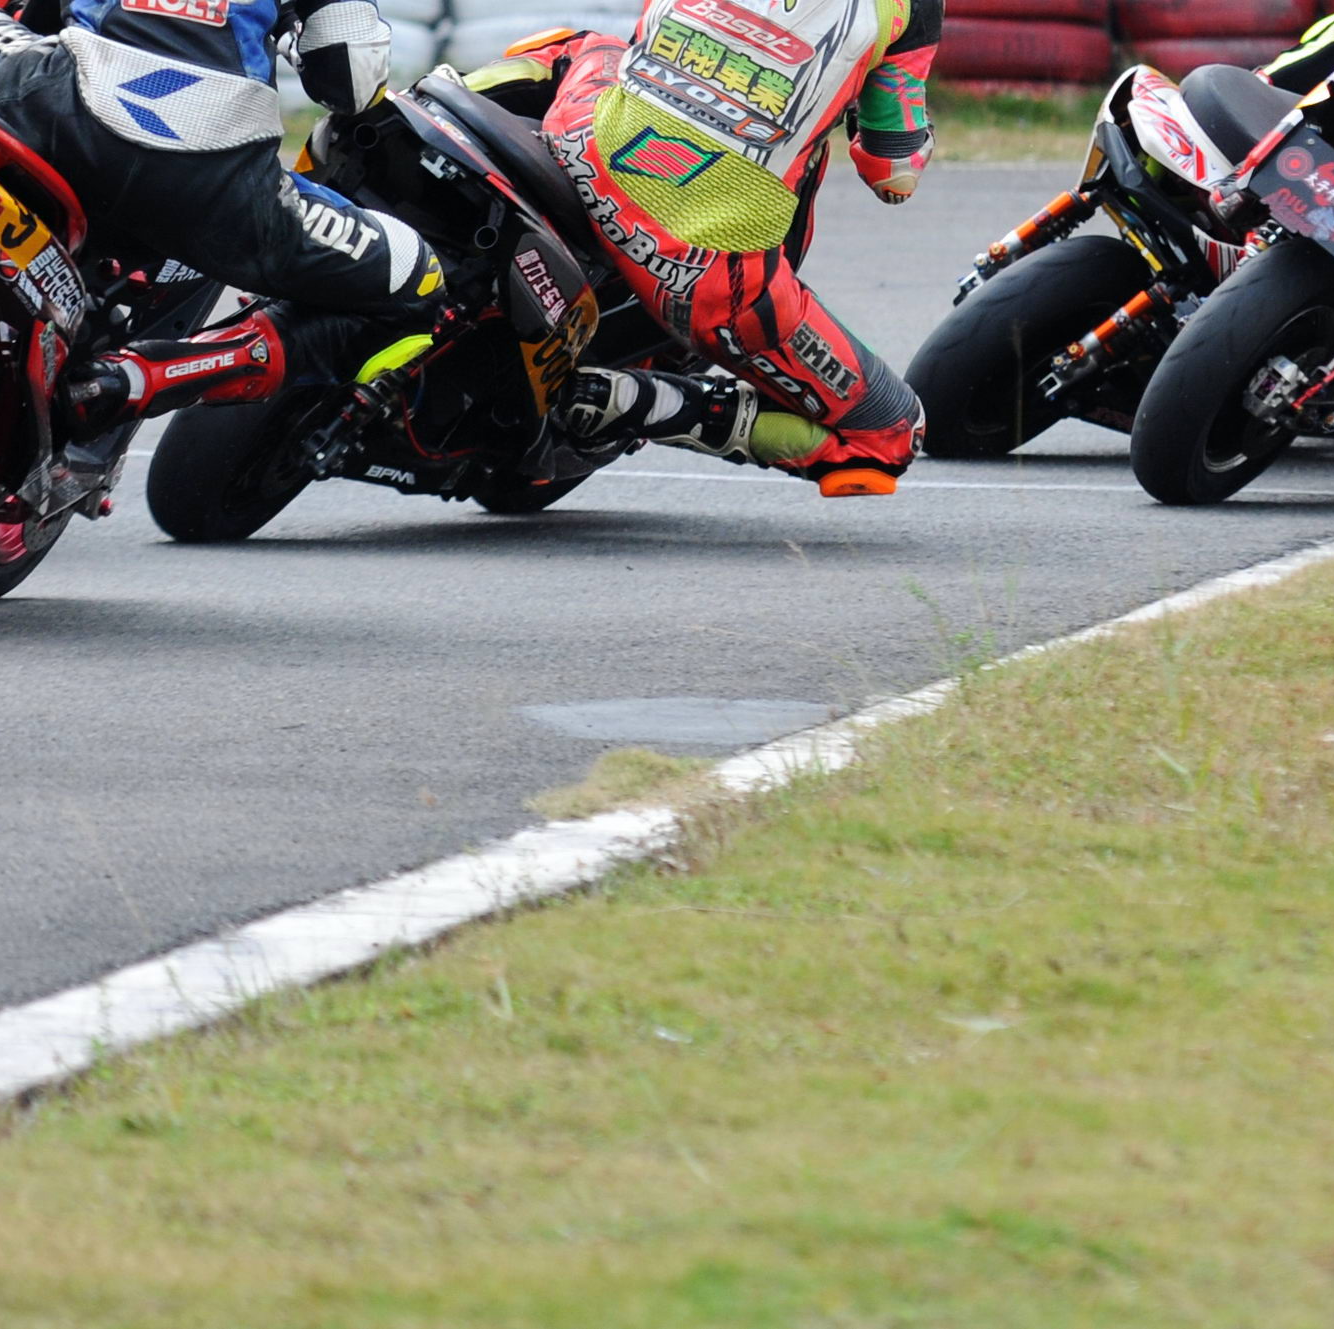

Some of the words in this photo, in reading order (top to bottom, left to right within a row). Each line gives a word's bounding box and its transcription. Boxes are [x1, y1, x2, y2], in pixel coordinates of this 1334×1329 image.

[650, 16, 795, 117] 百翔車業
[561, 134, 707, 293] MotoBuy
